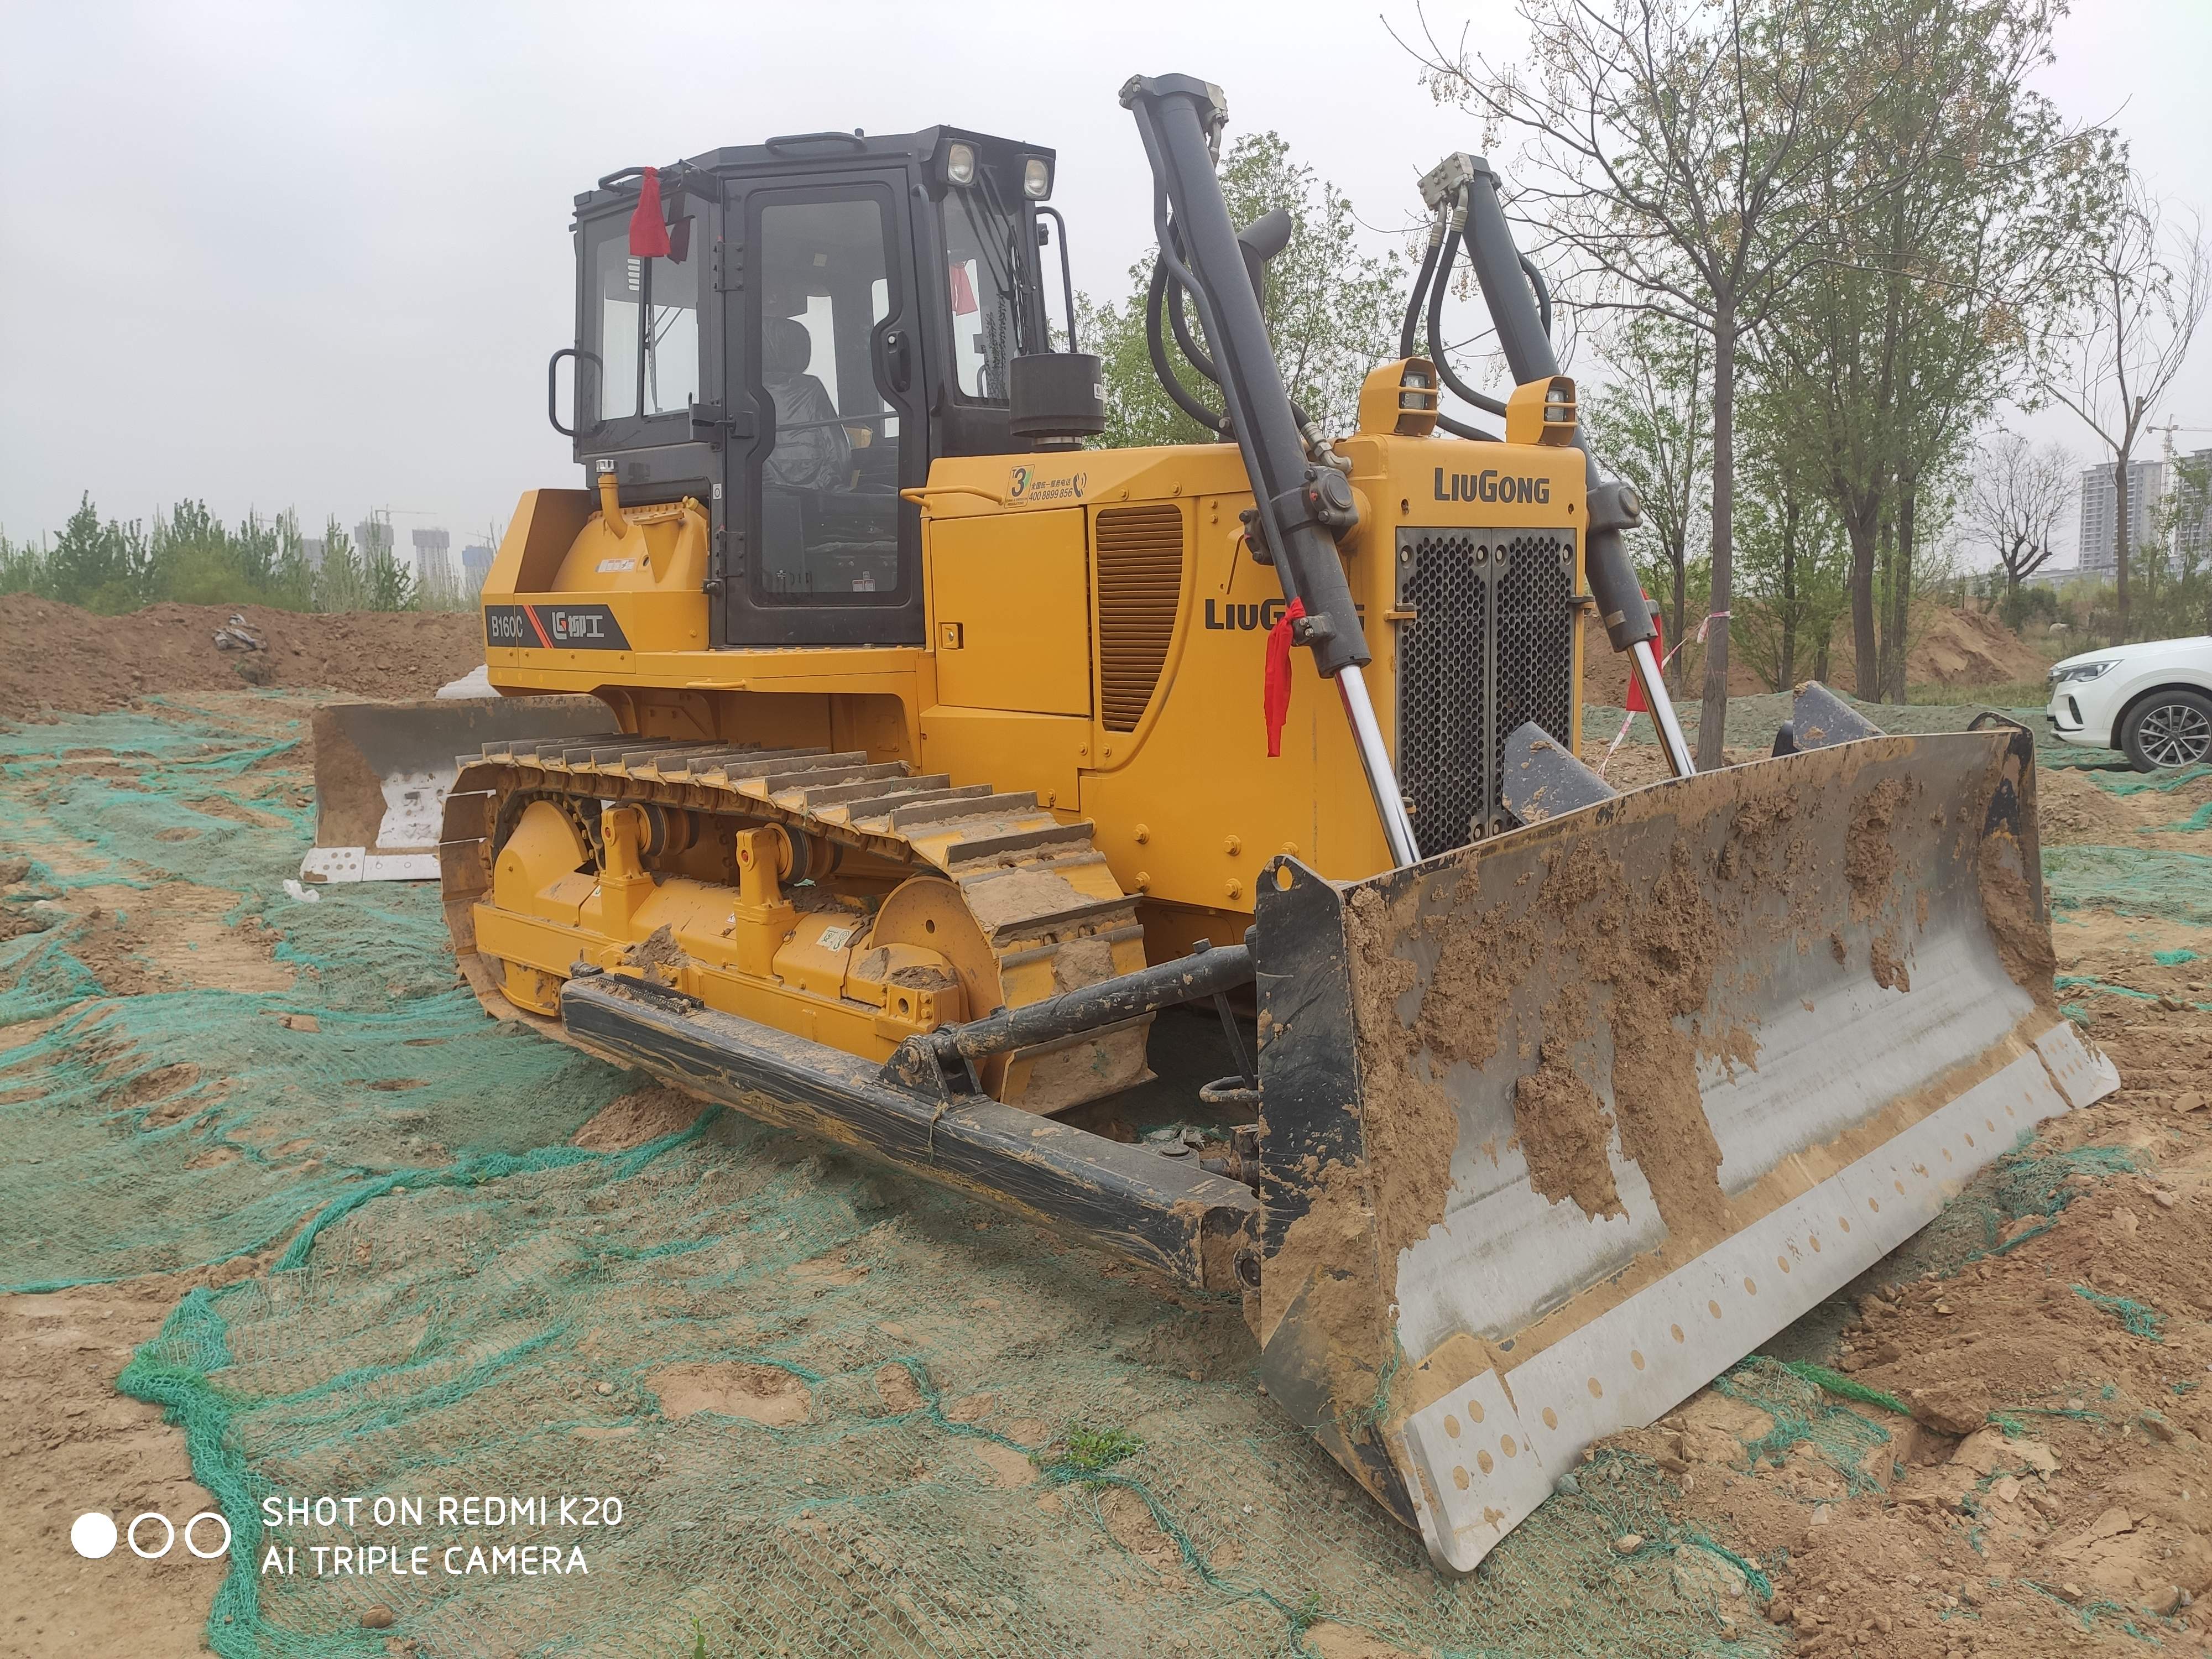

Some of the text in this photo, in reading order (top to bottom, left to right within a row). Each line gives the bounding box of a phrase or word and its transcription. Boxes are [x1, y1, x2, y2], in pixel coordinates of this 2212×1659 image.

[1031, 478, 1071, 490] 全国统一服务电话
[1029, 492, 1041, 502] 400
[1041, 489, 1059, 500] 8899
[1059, 488, 1073, 498] 856
[491, 615, 523, 638] B160C
